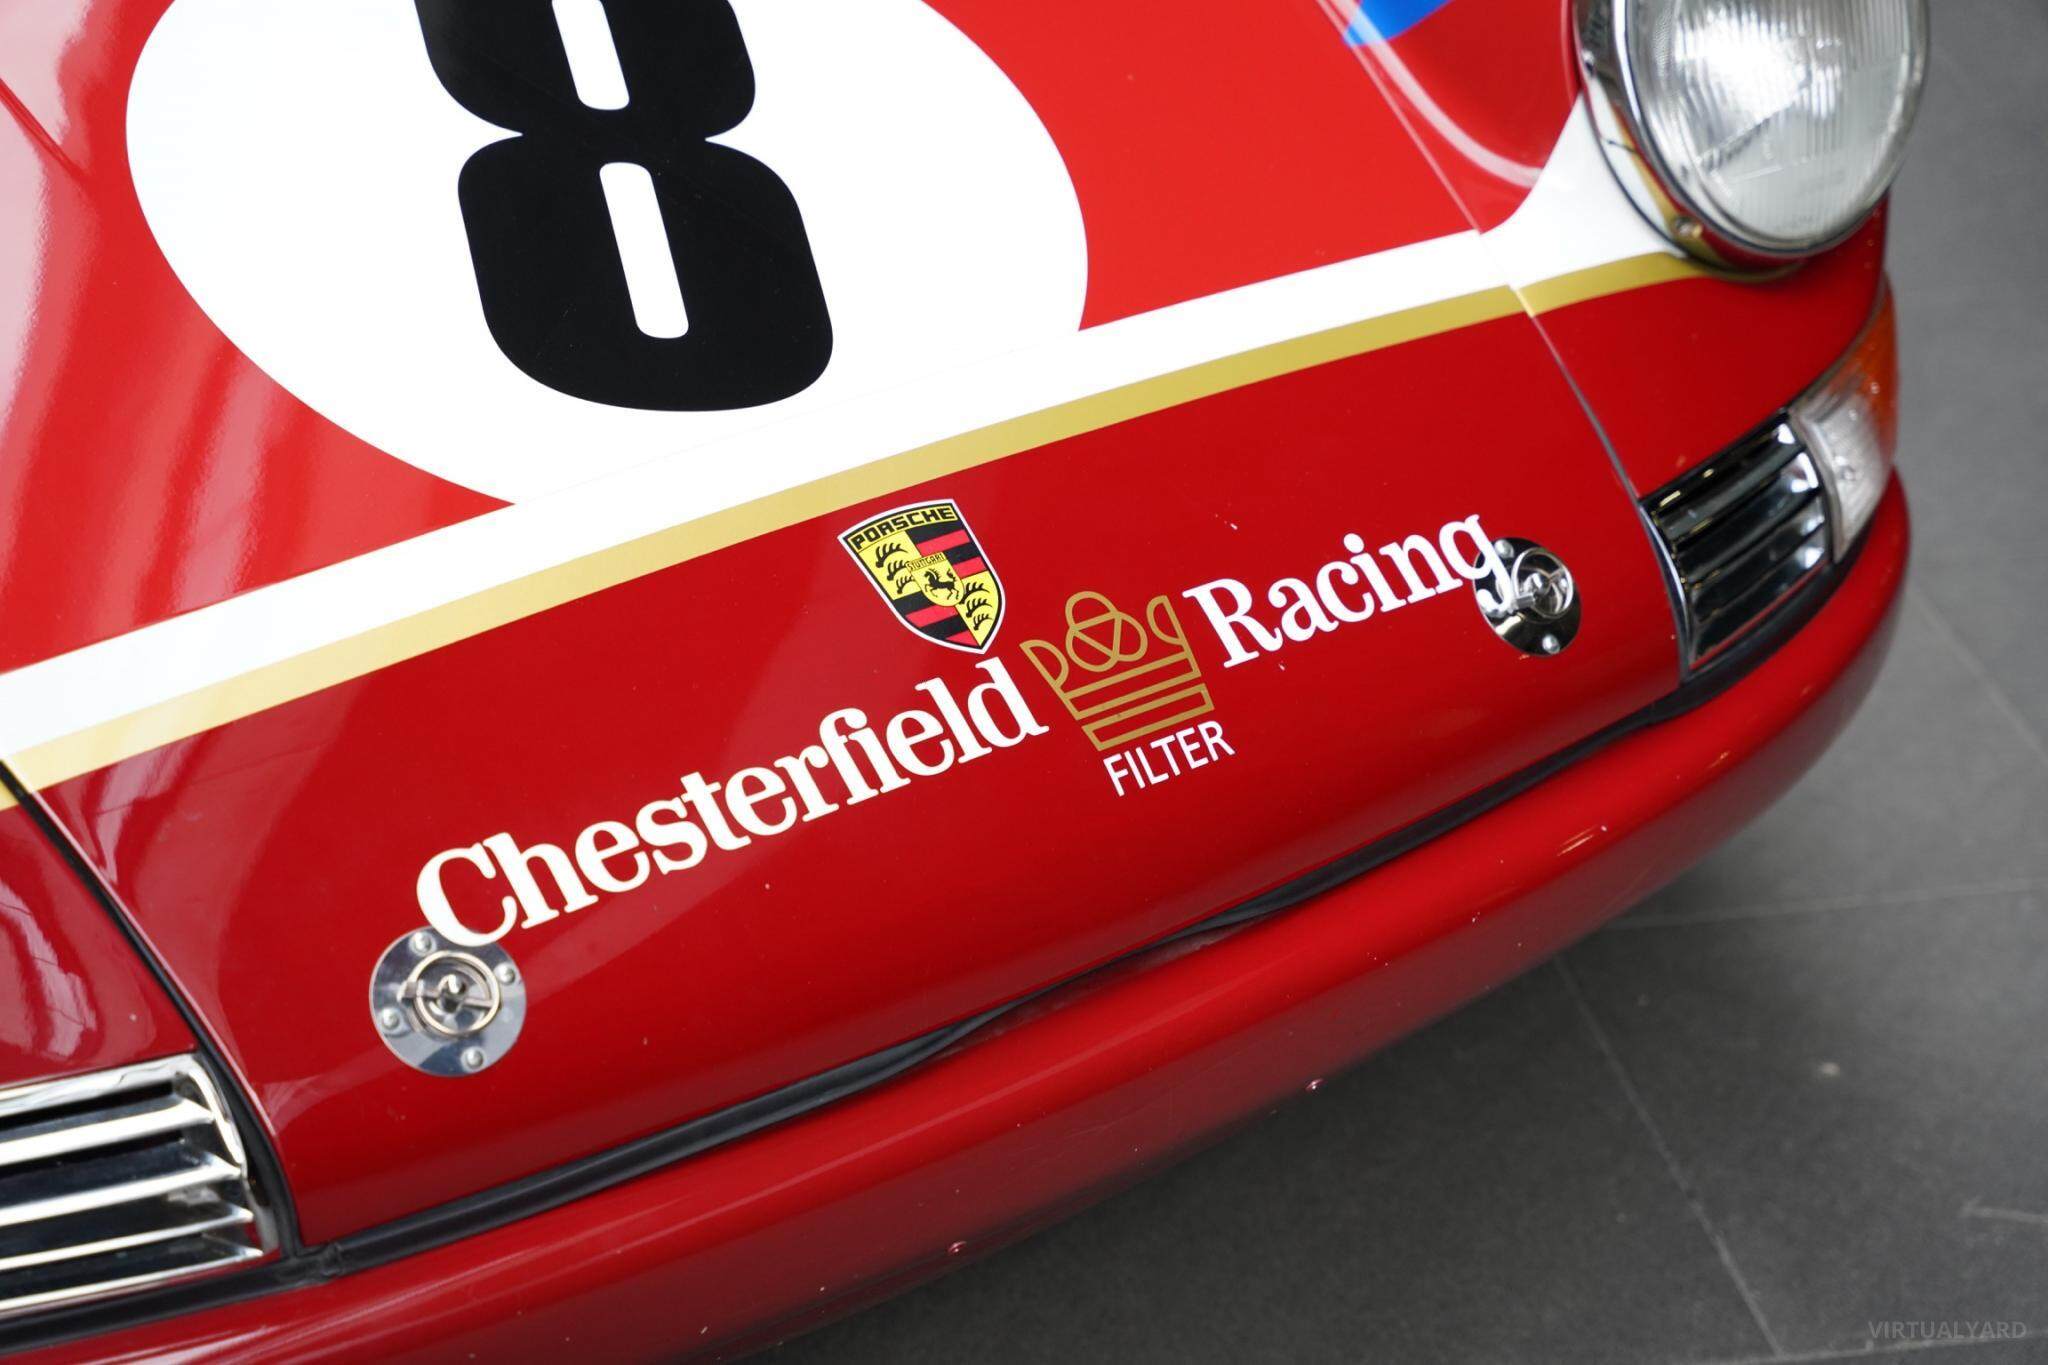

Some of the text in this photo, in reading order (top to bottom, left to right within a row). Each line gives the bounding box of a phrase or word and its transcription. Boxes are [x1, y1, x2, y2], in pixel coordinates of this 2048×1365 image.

[414, 0, 833, 412] 8
[851, 507, 955, 550] PORSCHE
[416, 514, 1514, 947] Chesterfield Racing
[1103, 720, 1235, 796] FILTER
